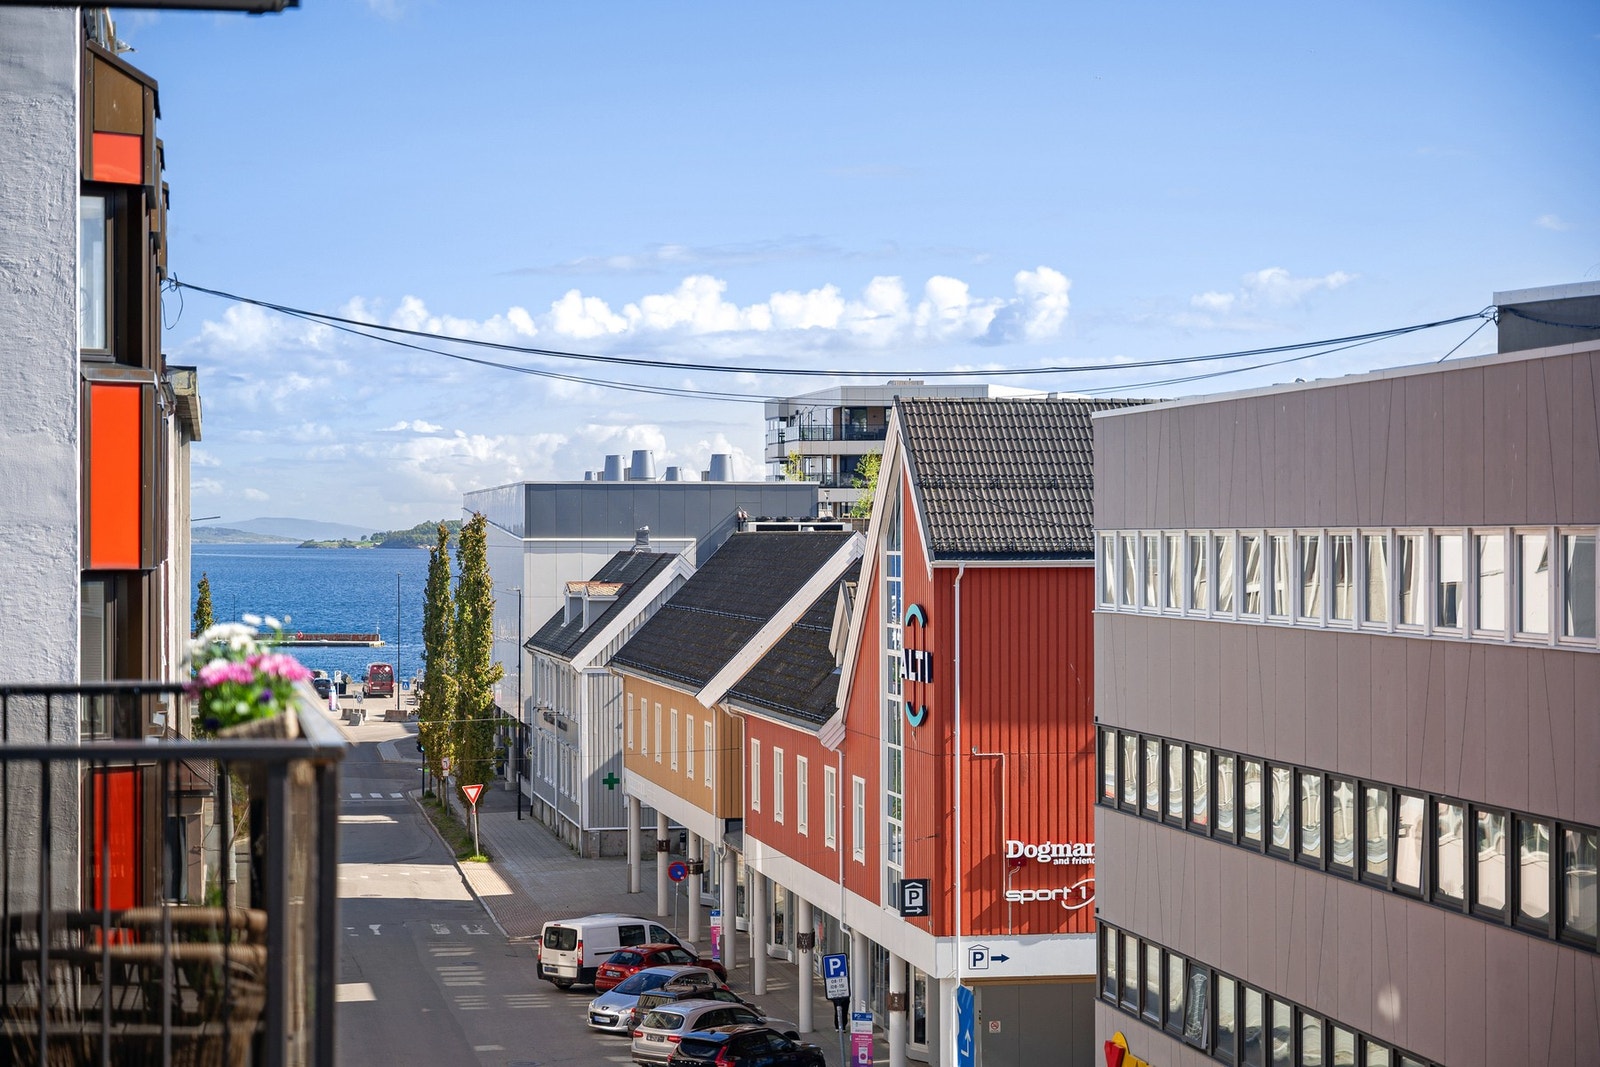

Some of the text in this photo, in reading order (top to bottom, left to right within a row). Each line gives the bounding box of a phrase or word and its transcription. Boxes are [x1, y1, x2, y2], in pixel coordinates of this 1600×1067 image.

[899, 648, 930, 684] ALTI
[1053, 857, 1070, 865] and
[908, 890, 920, 905] P
[829, 958, 841, 976] P
[972, 951, 984, 967] P
